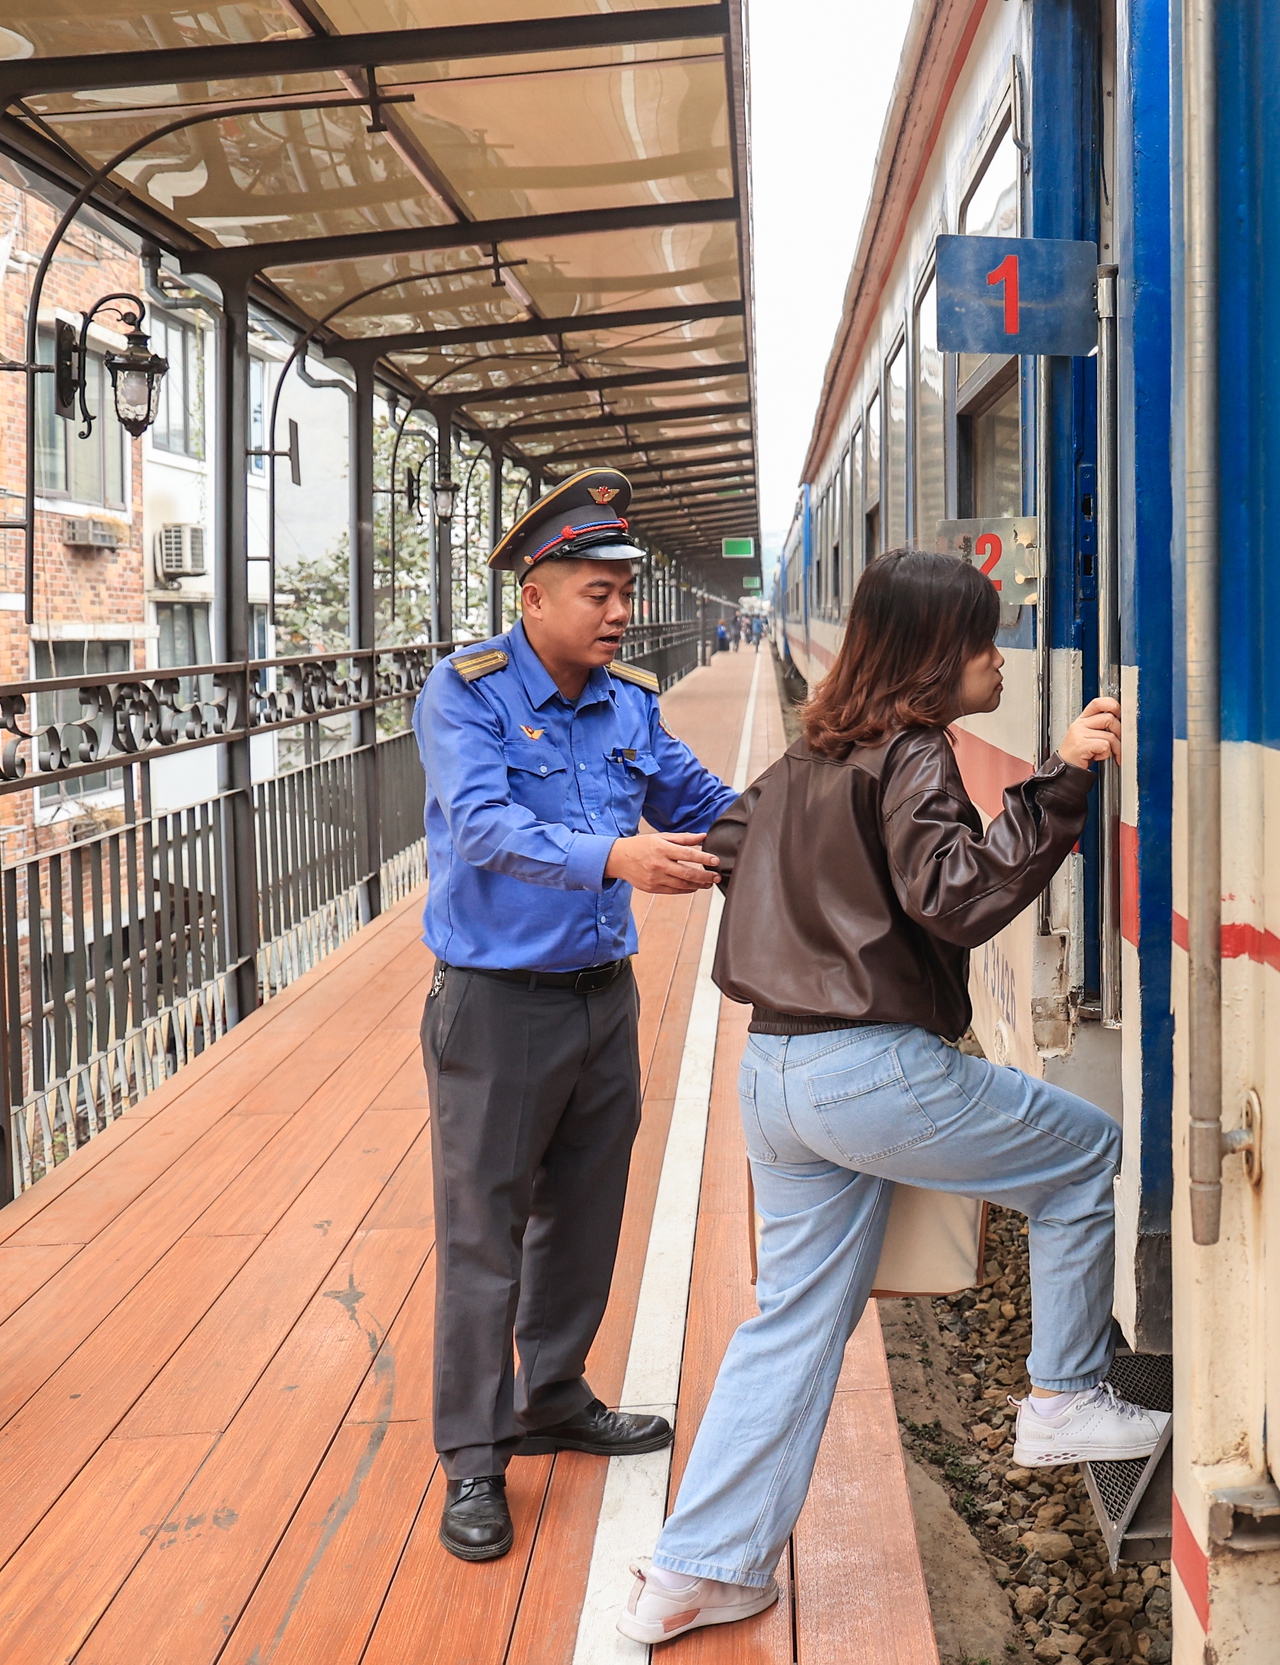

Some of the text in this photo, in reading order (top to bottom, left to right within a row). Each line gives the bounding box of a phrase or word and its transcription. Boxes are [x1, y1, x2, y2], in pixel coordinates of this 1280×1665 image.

[986, 254, 1020, 335] 1
[975, 532, 1003, 591] 2
[991, 938, 1016, 1033] 31426
